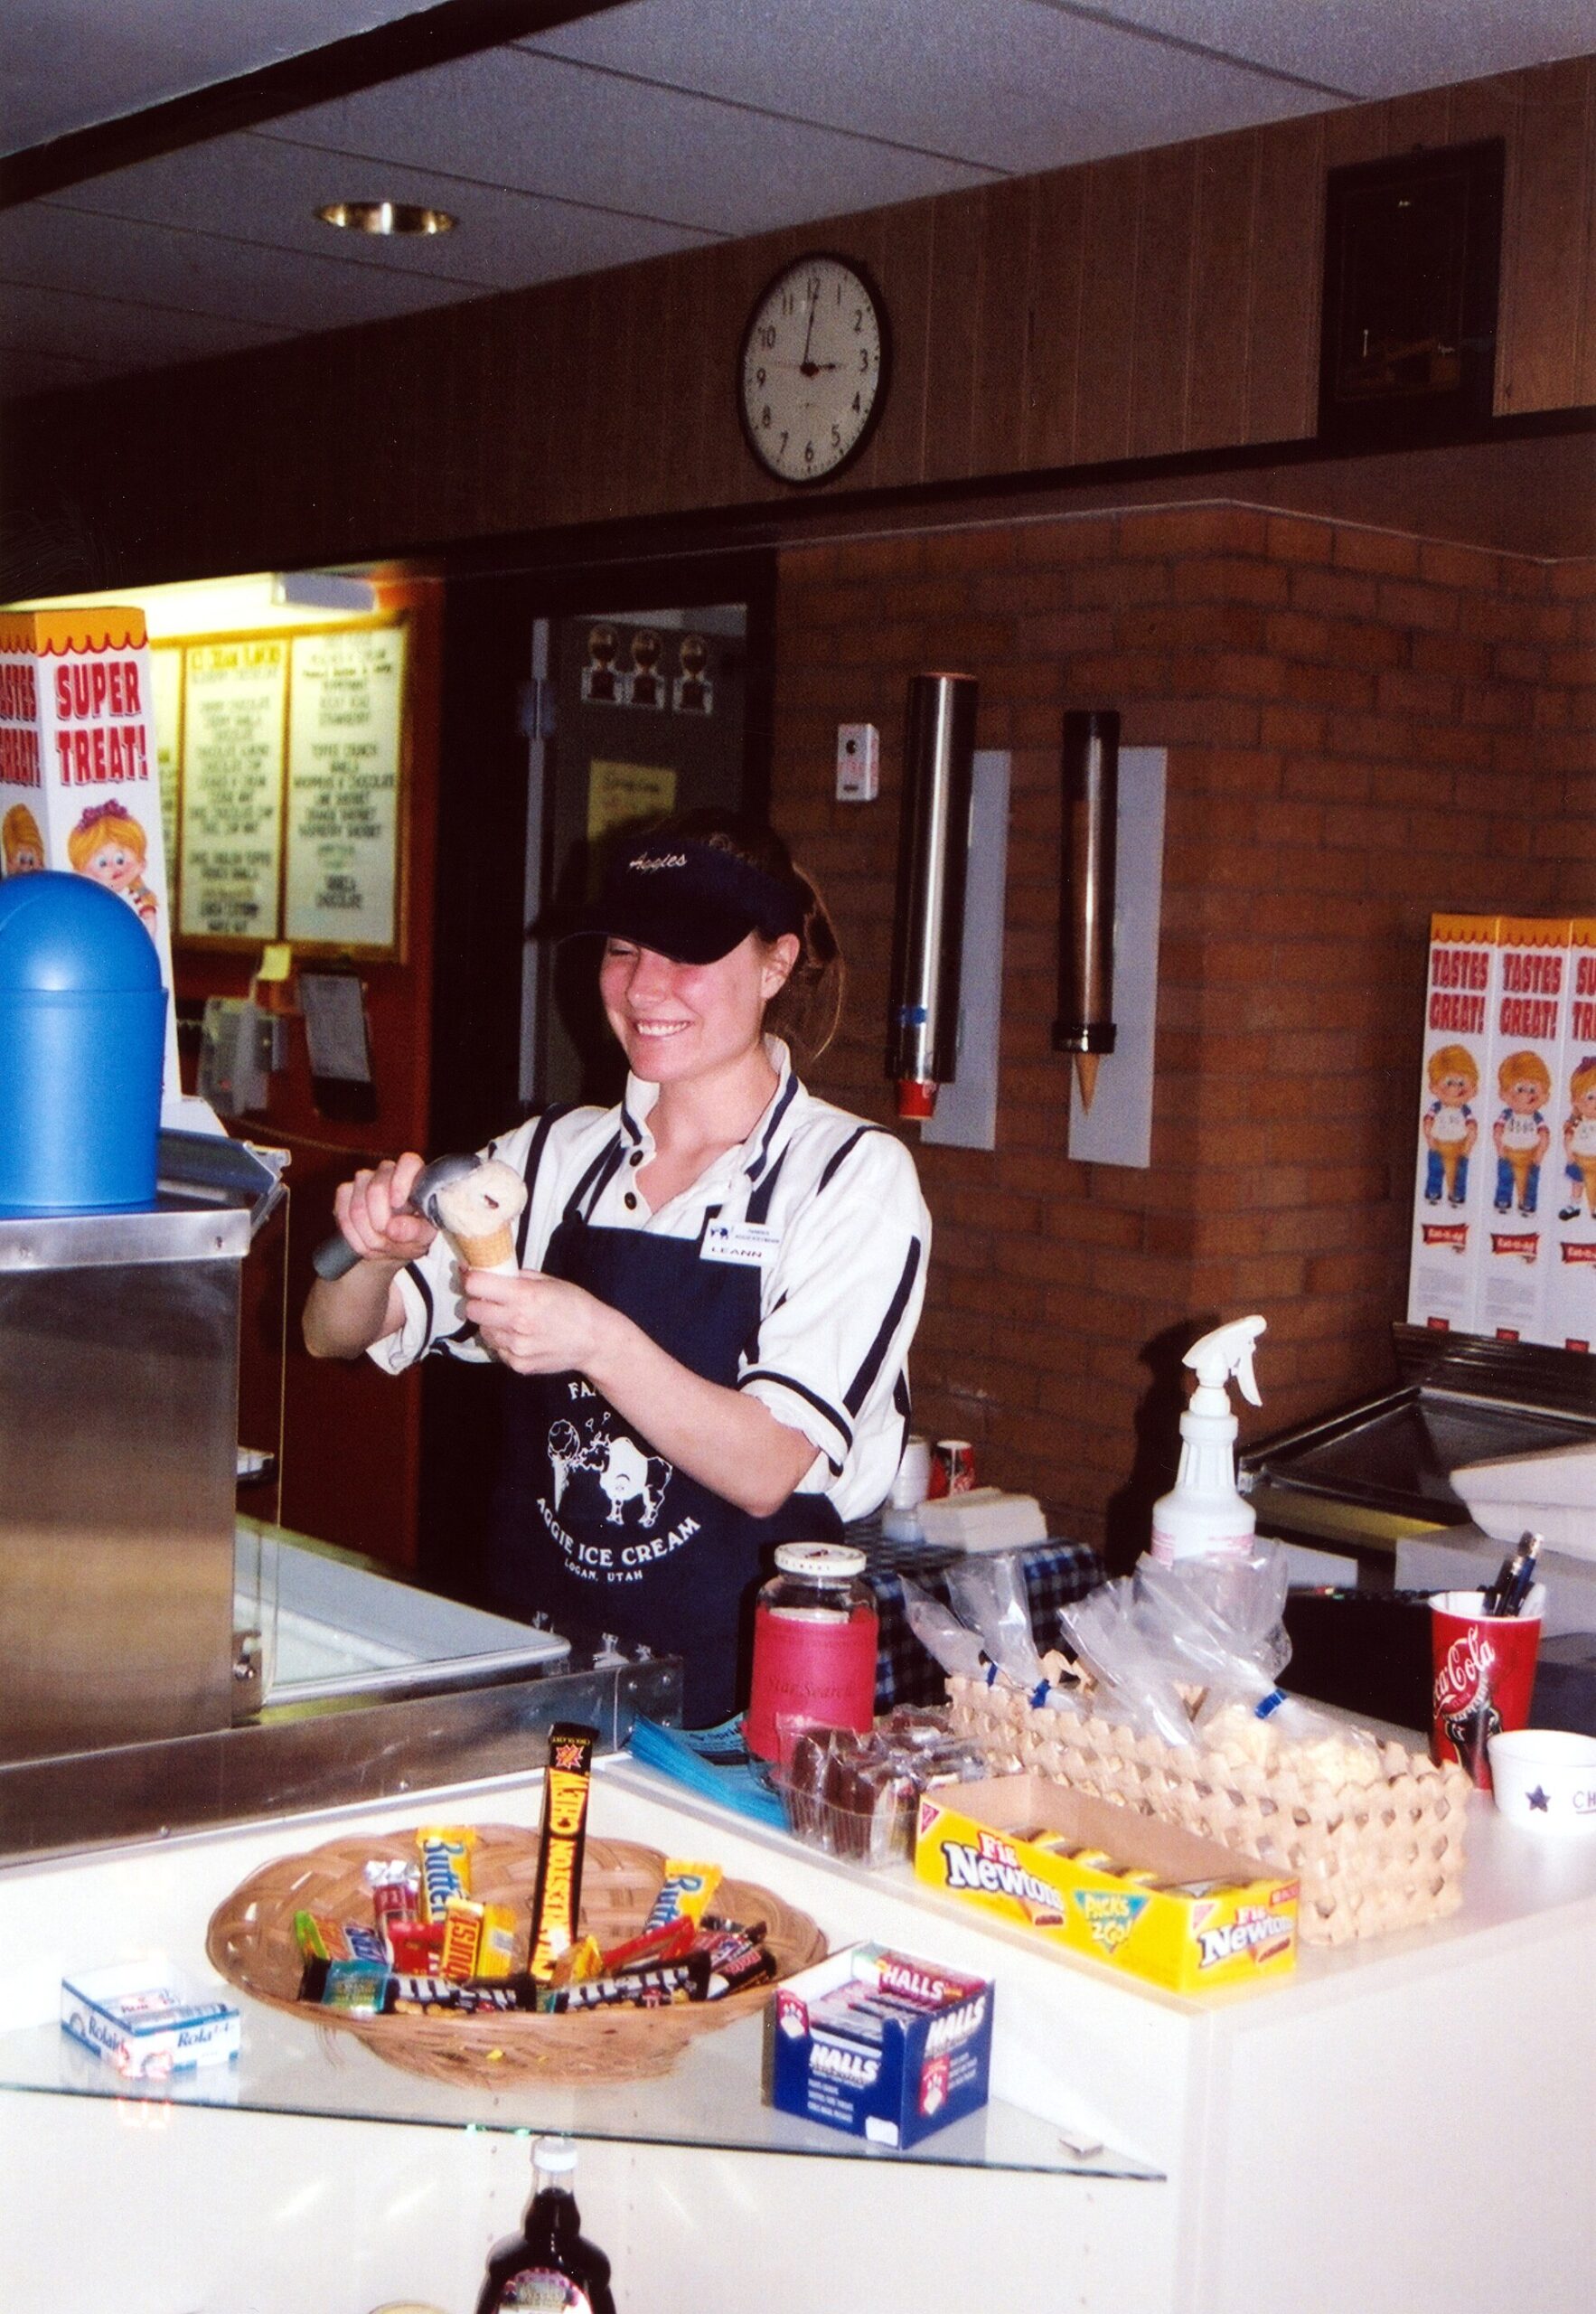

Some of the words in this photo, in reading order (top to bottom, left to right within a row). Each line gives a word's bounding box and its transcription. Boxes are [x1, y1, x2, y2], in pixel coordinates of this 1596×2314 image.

[782, 292, 793, 315] 11
[807, 277, 821, 302] 12
[835, 282, 841, 306] 1
[853, 308, 863, 333] 2
[757, 325, 776, 349] 10
[859, 348, 869, 373] 3
[756, 367, 766, 387] 9
[762, 405, 772, 429] 8
[851, 391, 861, 414] 4
[780, 430, 790, 455] 7
[831, 424, 841, 447] 5
[804, 440, 814, 463] 6
[54, 661, 142, 721] SUPER
[56, 724, 149, 786] TREAT!
[1432, 948, 1489, 991] TASTES
[1503, 952, 1563, 994] TASTES
[1429, 992, 1485, 1034] GREAT!
[1499, 997, 1558, 1039] GREAT!
[568, 1381, 596, 1400] FA
[536, 1497, 575, 1557] AGGIE
[578, 1542, 615, 1566] ICE
[621, 1516, 701, 1566] CREAM
[606, 1569, 644, 1583] UTAH
[549, 1768, 590, 1836] CHEW
[977, 1830, 1020, 1869] Fig
[423, 1839, 465, 1924] Butter
[941, 1840, 1066, 1913] Newtons
[883, 1965, 946, 2000] HALLS
[926, 1995, 987, 2051] HALLS
[809, 2043, 879, 2083] HALLS
